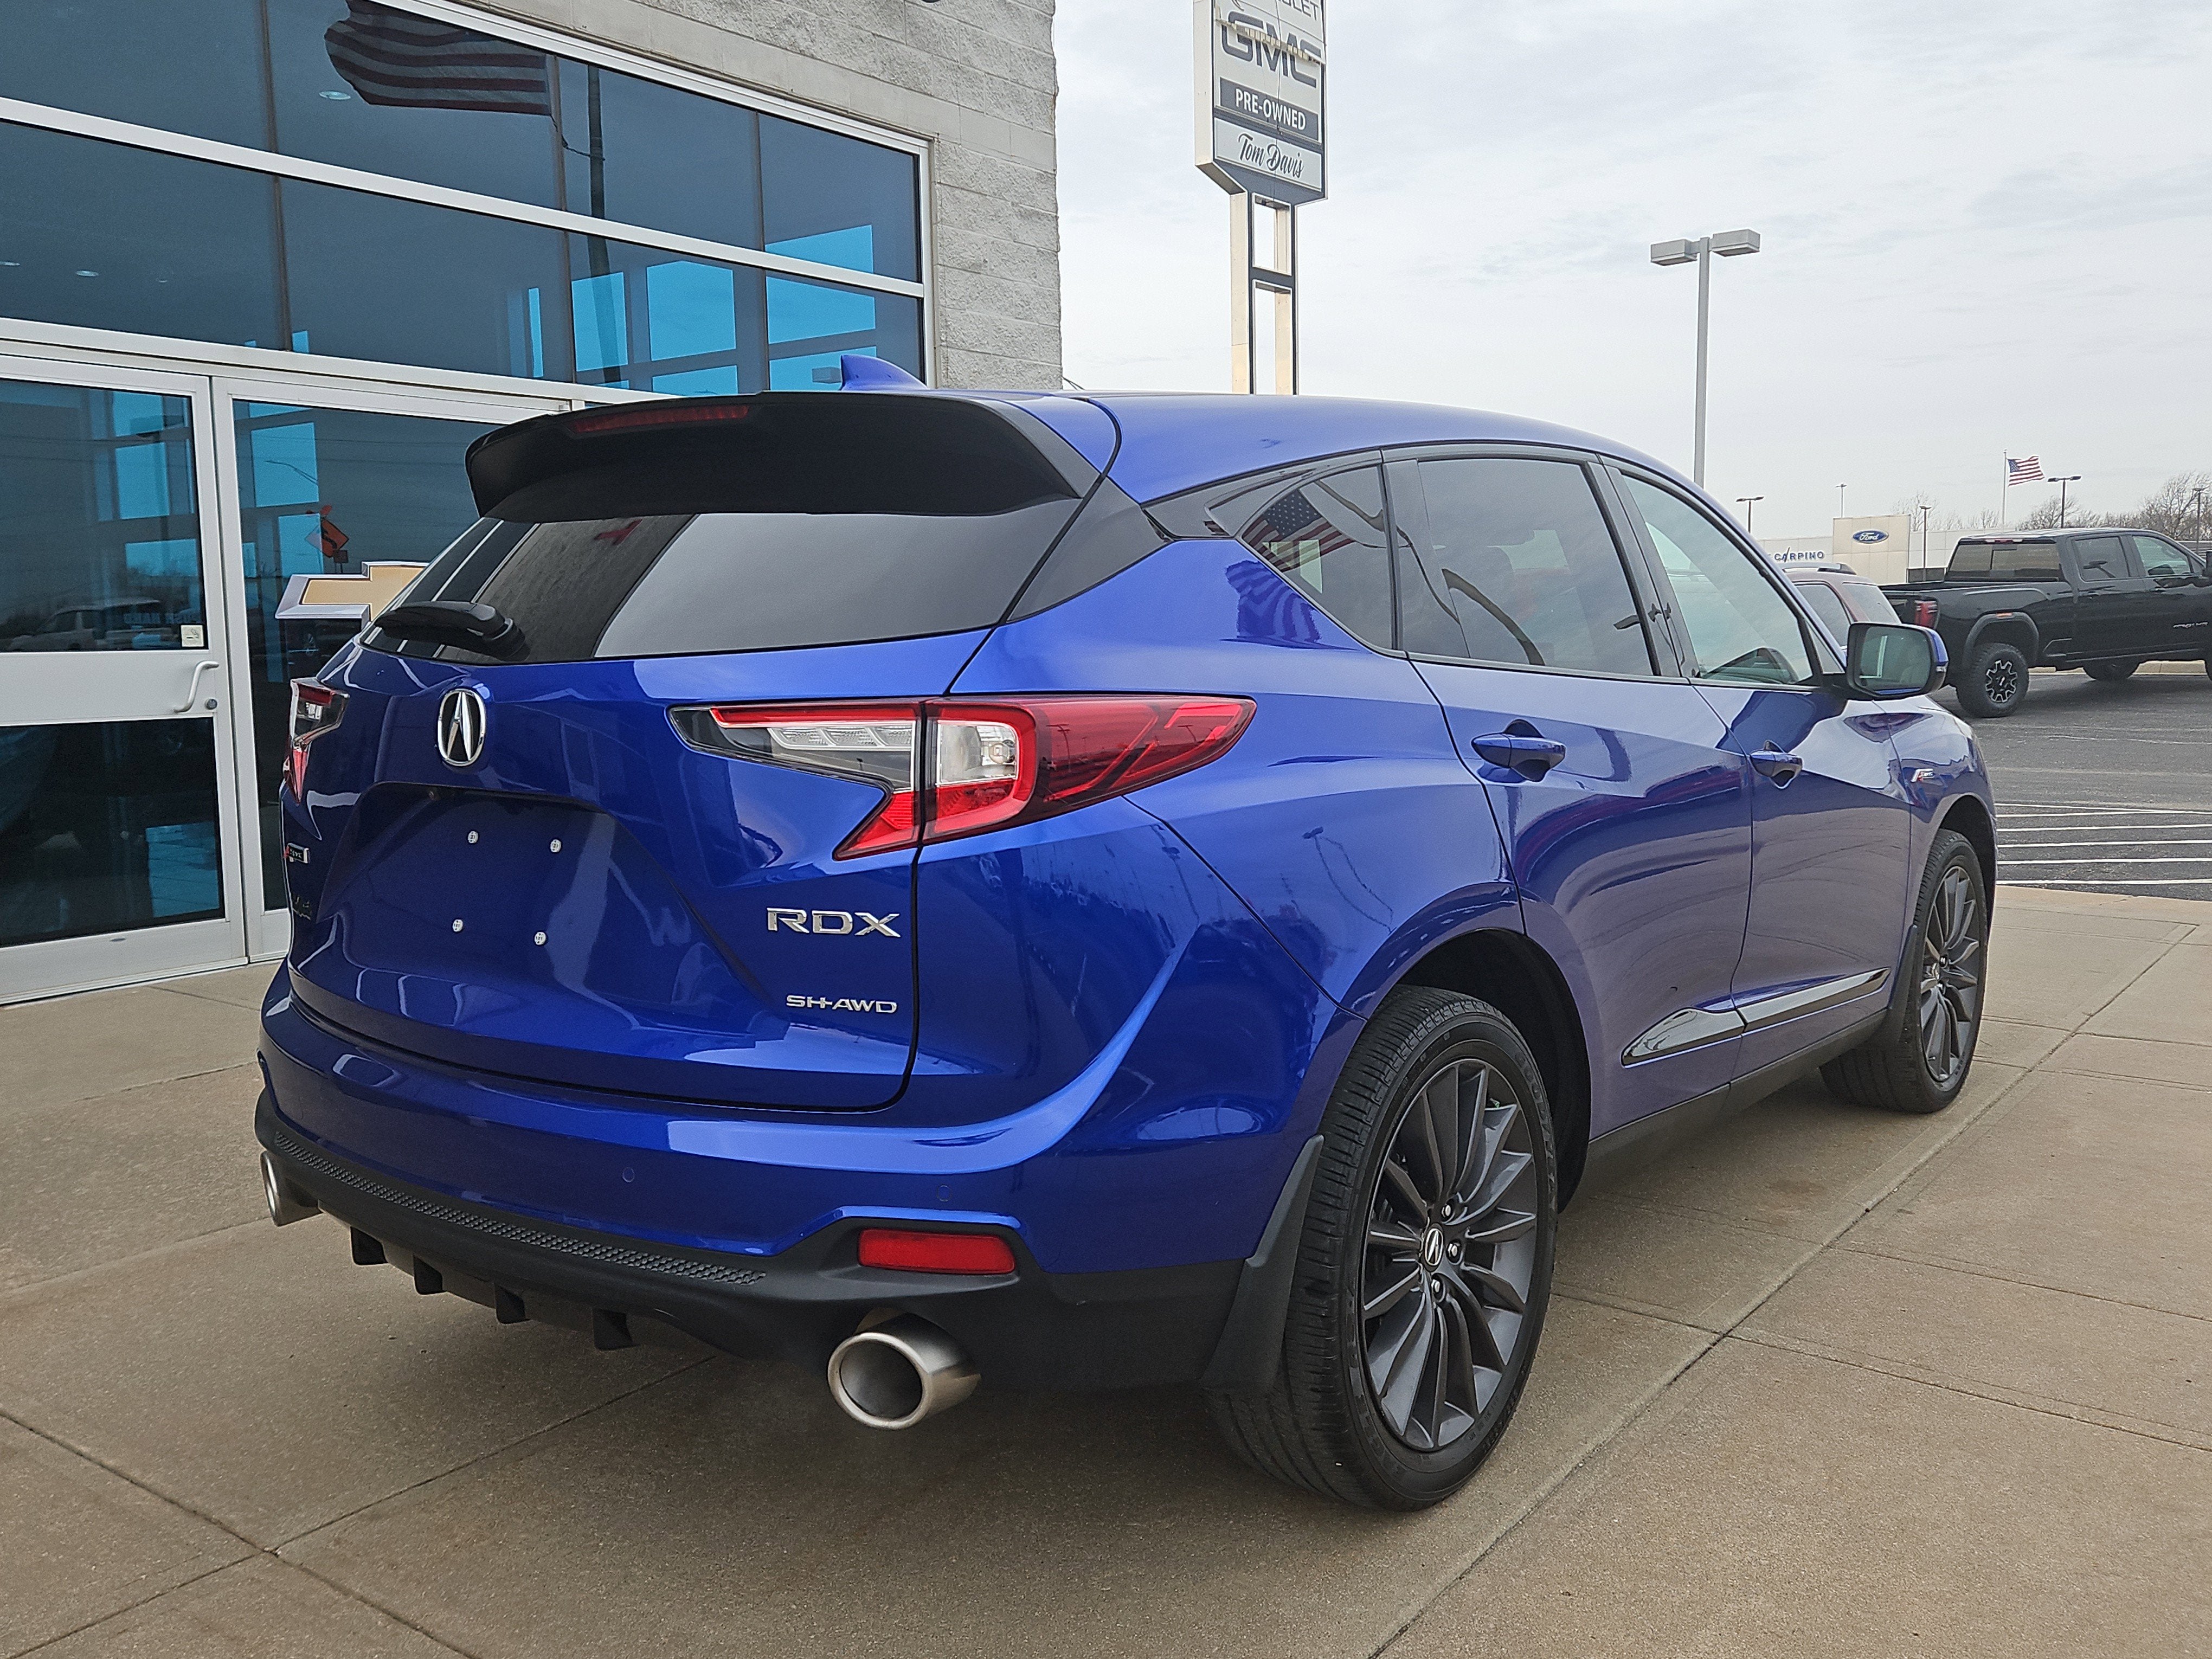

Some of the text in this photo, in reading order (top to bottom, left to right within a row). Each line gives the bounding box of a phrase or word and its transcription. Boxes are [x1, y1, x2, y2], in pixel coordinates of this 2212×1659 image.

[1221, 11, 1321, 89] GMC
[1235, 88, 1306, 131] PRE-OWNED
[1238, 133, 1304, 179] Tom Davis
[1774, 549, 1824, 562] CARPINO
[766, 907, 901, 938] RDX
[786, 994, 898, 1013] SH-AWD
